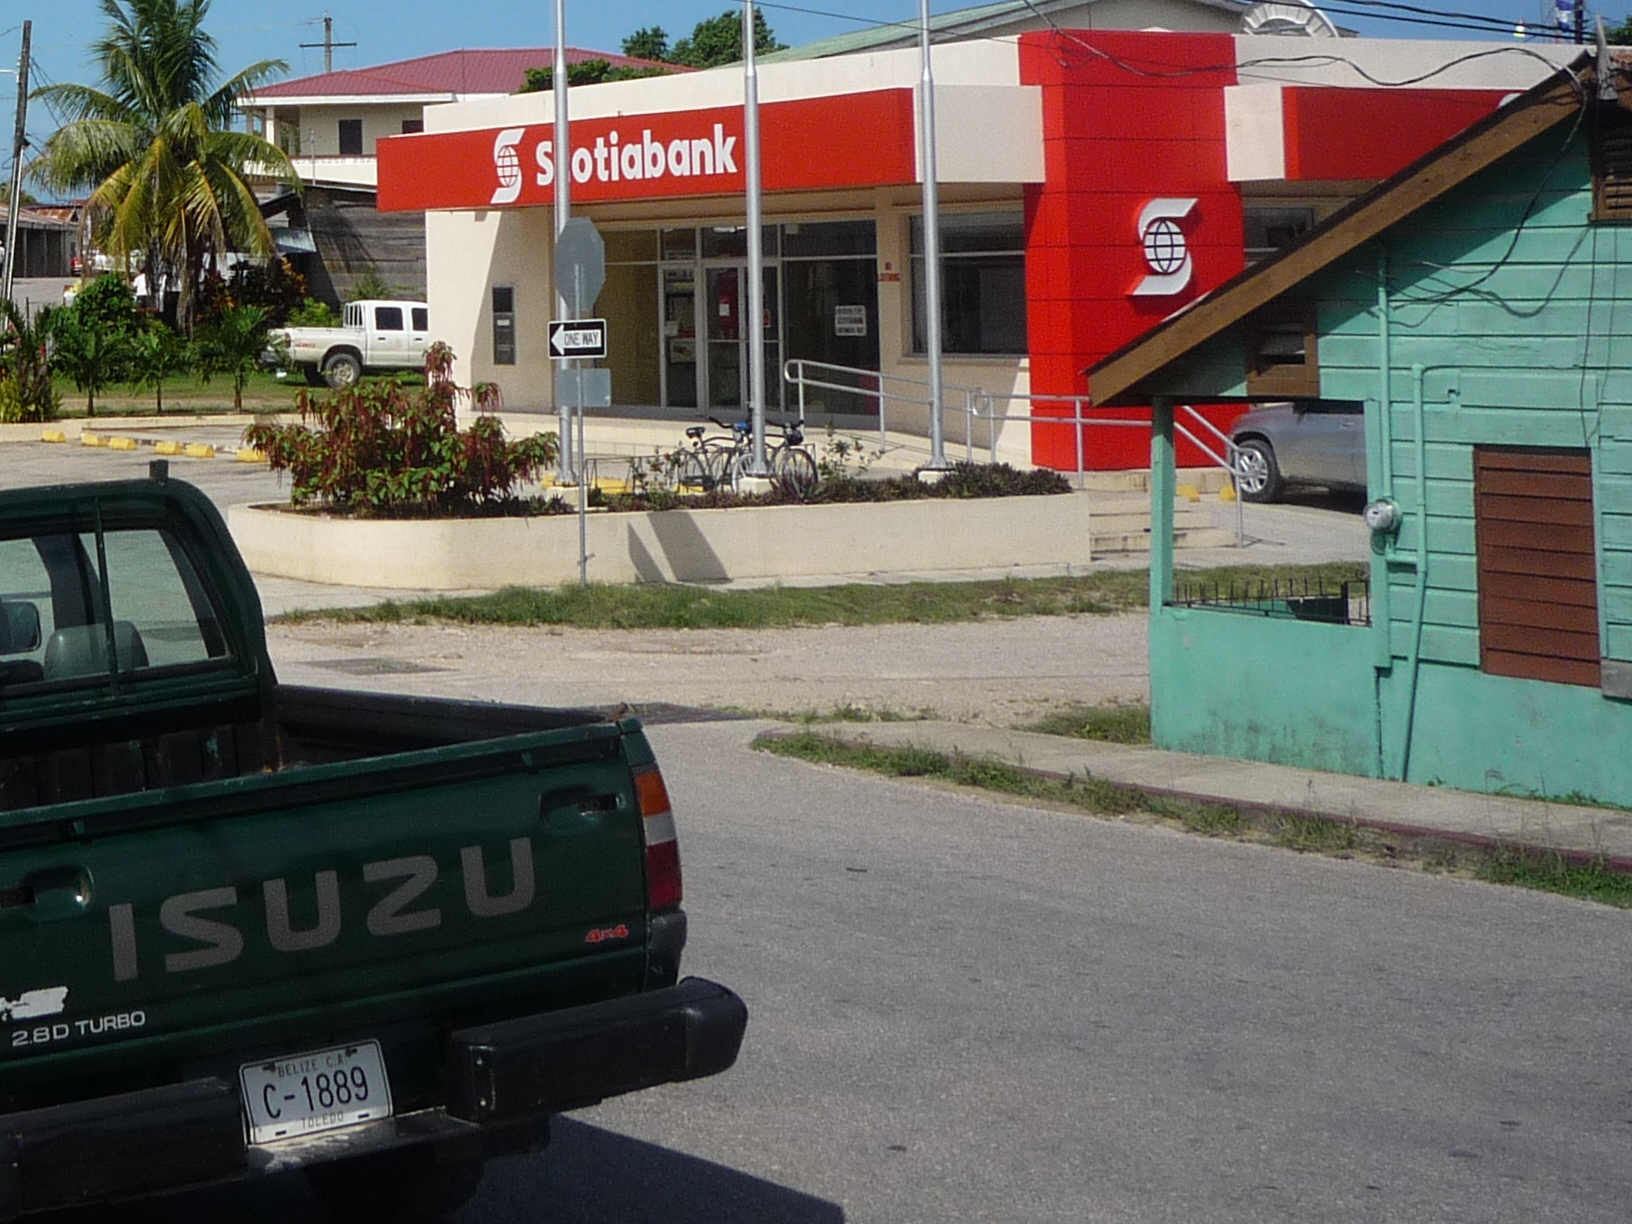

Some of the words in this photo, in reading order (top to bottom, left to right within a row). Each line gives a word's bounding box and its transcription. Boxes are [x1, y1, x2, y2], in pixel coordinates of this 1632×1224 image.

[535, 123, 737, 186] Sotiabank
[564, 332, 580, 346] ONE
[582, 331, 599, 345] WAY
[109, 837, 536, 982] ISUZU
[74, 1010, 146, 1036] TURBO
[277, 1059, 318, 1078] BELIZE
[262, 1065, 369, 1120] C-1889
[300, 1111, 345, 1129] TOLEDO
